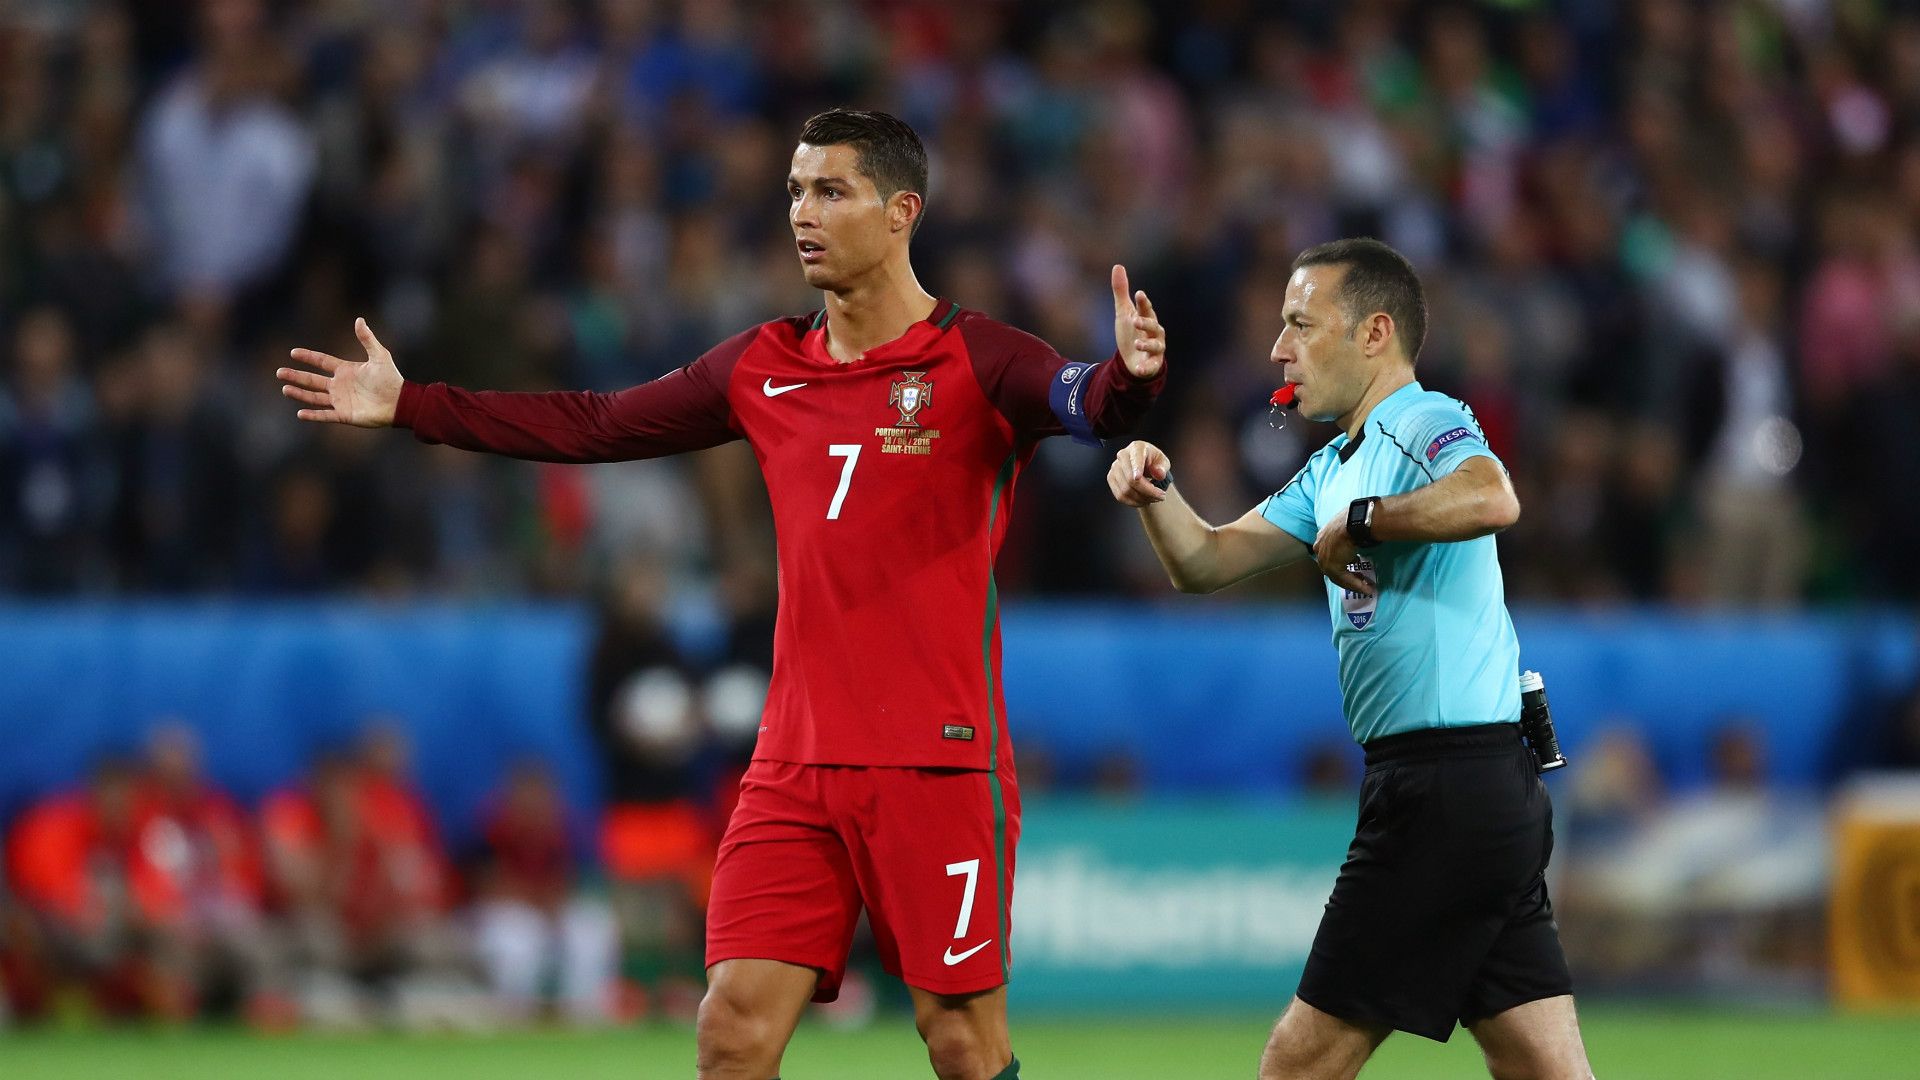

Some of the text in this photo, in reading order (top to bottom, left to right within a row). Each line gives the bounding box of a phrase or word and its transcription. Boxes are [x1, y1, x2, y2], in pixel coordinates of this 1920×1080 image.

[875, 427, 907, 437] PORTUGAL
[884, 436, 892, 445] 14
[913, 438, 931, 446] 2016
[826, 444, 863, 520] 7
[1352, 615, 1367, 624] 2016
[945, 859, 980, 939] 7
